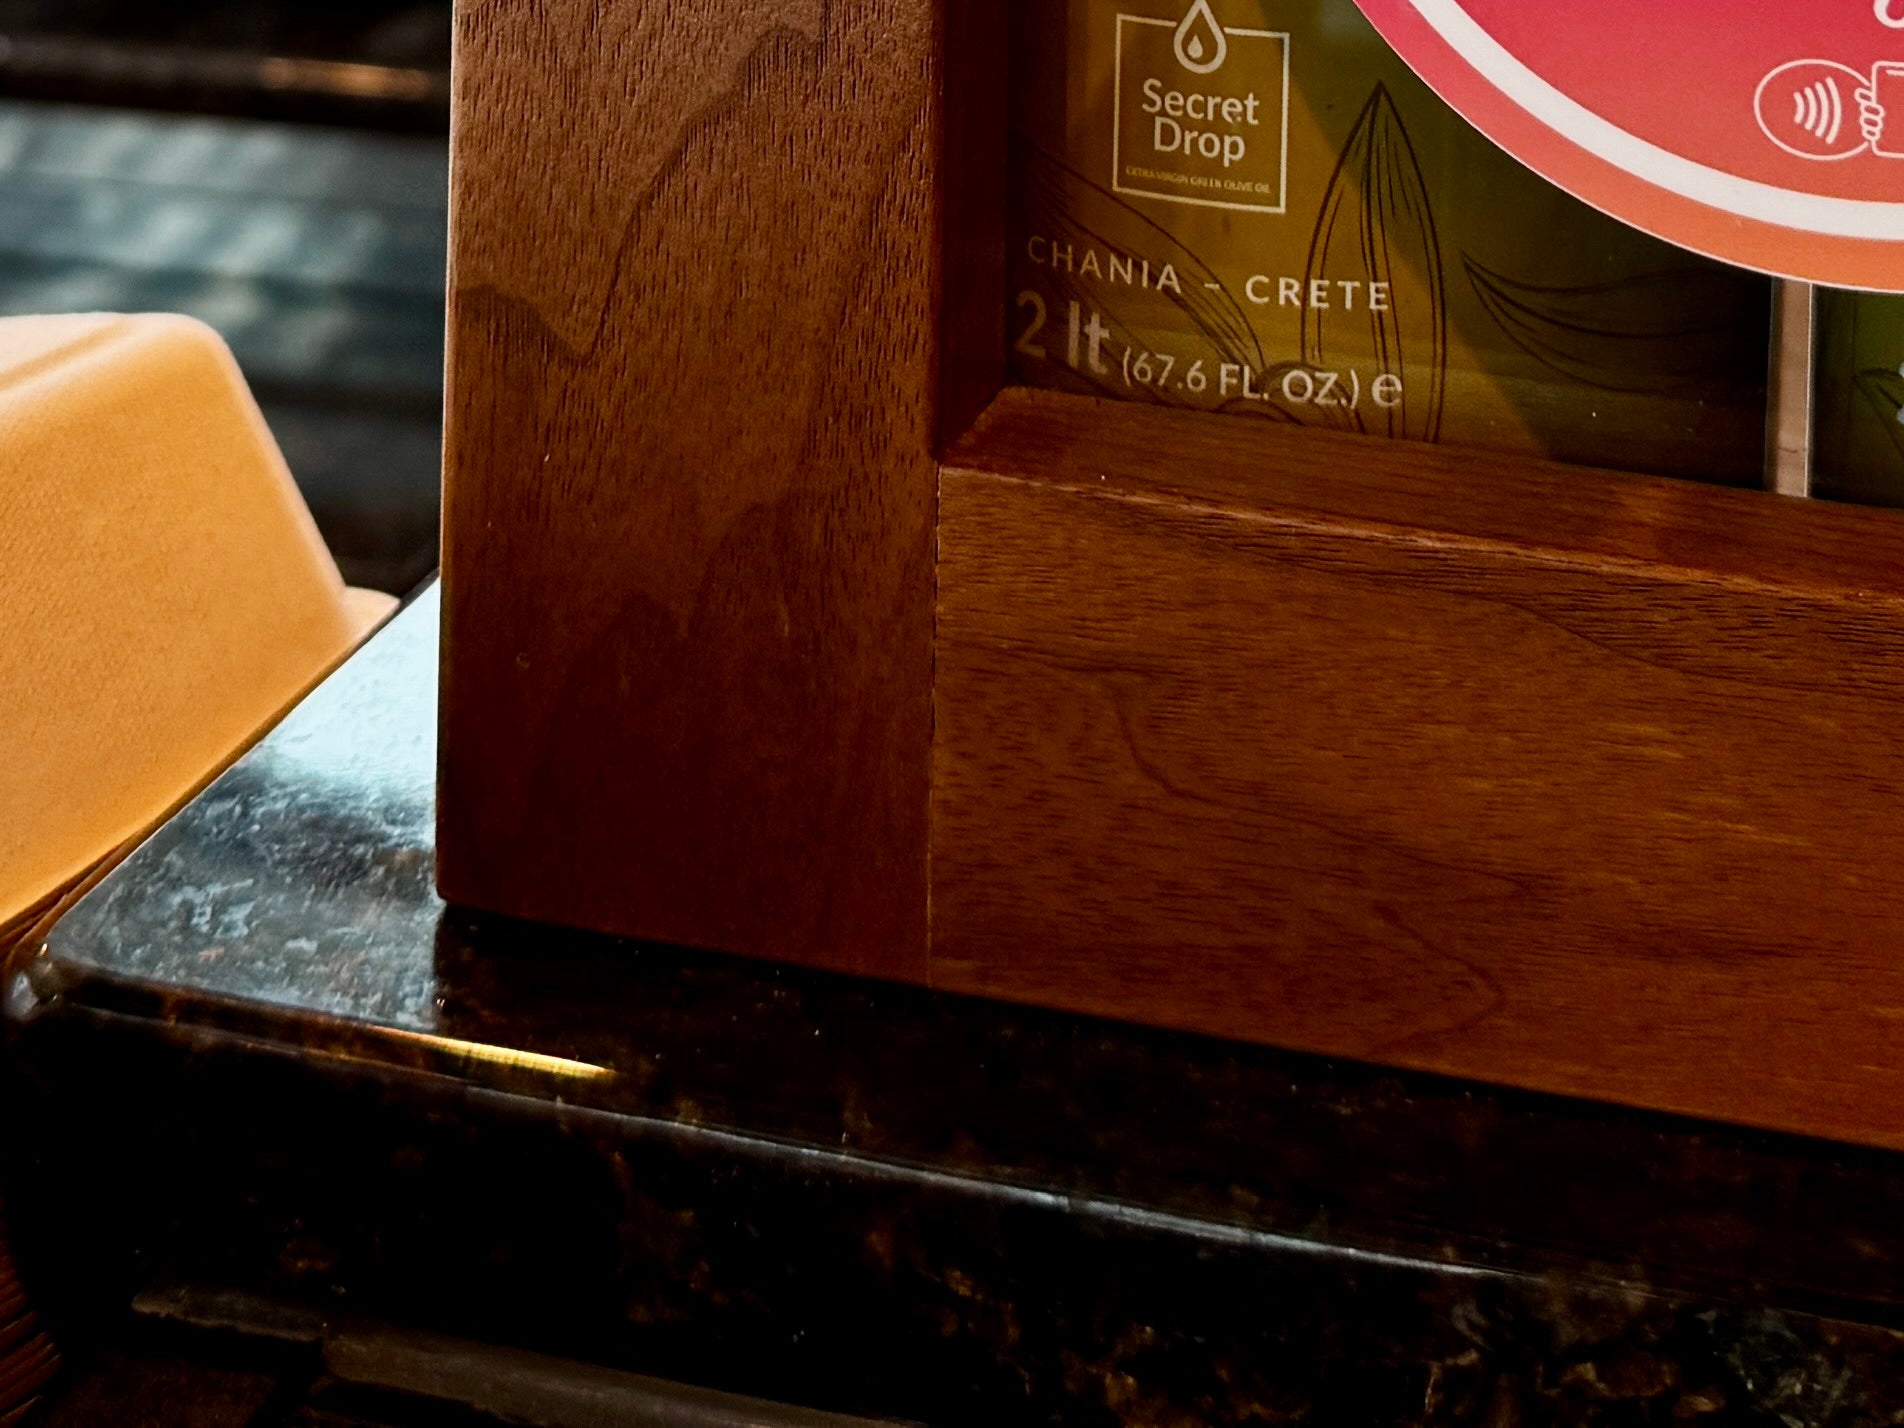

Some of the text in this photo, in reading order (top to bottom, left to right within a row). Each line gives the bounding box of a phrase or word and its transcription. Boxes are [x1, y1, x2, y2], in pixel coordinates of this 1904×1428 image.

[1141, 78, 1260, 127] Secret
[1152, 116, 1247, 167] Drop
[1028, 234, 1182, 295] CHANIA
[1244, 273, 1391, 311] CRETE
[1015, 290, 1047, 358] 2
[1121, 346, 1208, 393] (67.6
[1218, 361, 1270, 400] FL.
[1281, 368, 1361, 410] OZ.)
